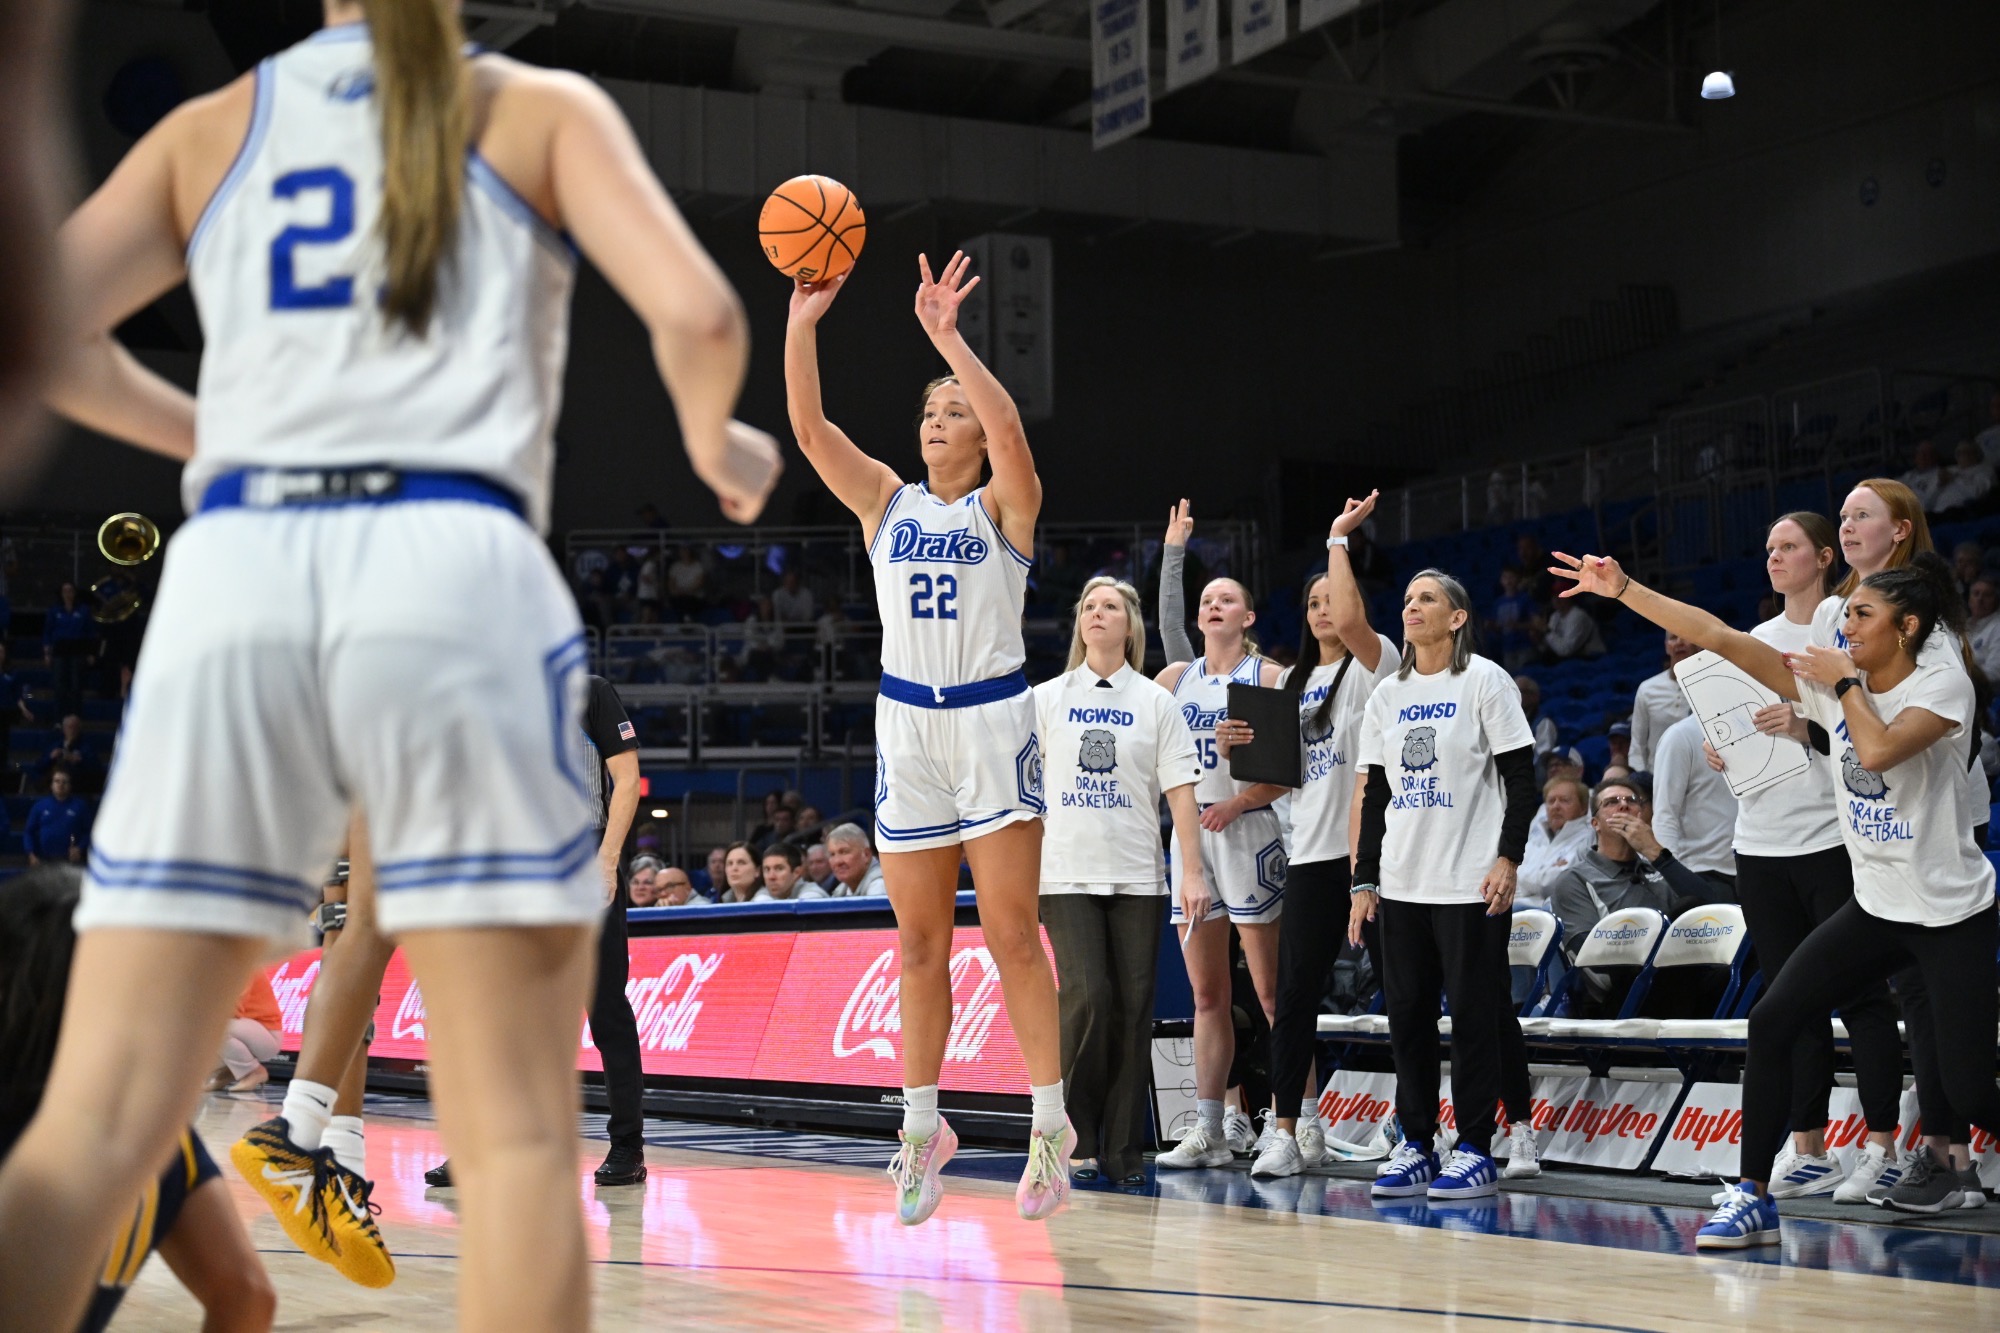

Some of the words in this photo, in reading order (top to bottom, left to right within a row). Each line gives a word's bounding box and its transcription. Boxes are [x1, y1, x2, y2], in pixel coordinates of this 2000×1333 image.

[271, 166, 386, 311] 2
[889, 518, 988, 565] Drake
[909, 573, 958, 620] 22
[1068, 707, 1134, 727] NGWSD
[1181, 702, 1228, 730] Drak
[1398, 702, 1457, 724] NGWSD
[1076, 776, 1119, 792] DRAKE
[1061, 792, 1133, 808] BASKETBALL
[1509, 926, 1543, 941] adlawns
[1593, 924, 1650, 940] broadlawns
[1671, 921, 1734, 938] broadlawns
[1564, 1098, 1658, 1143] HyVee
[1672, 1106, 1742, 1151] HyVe
